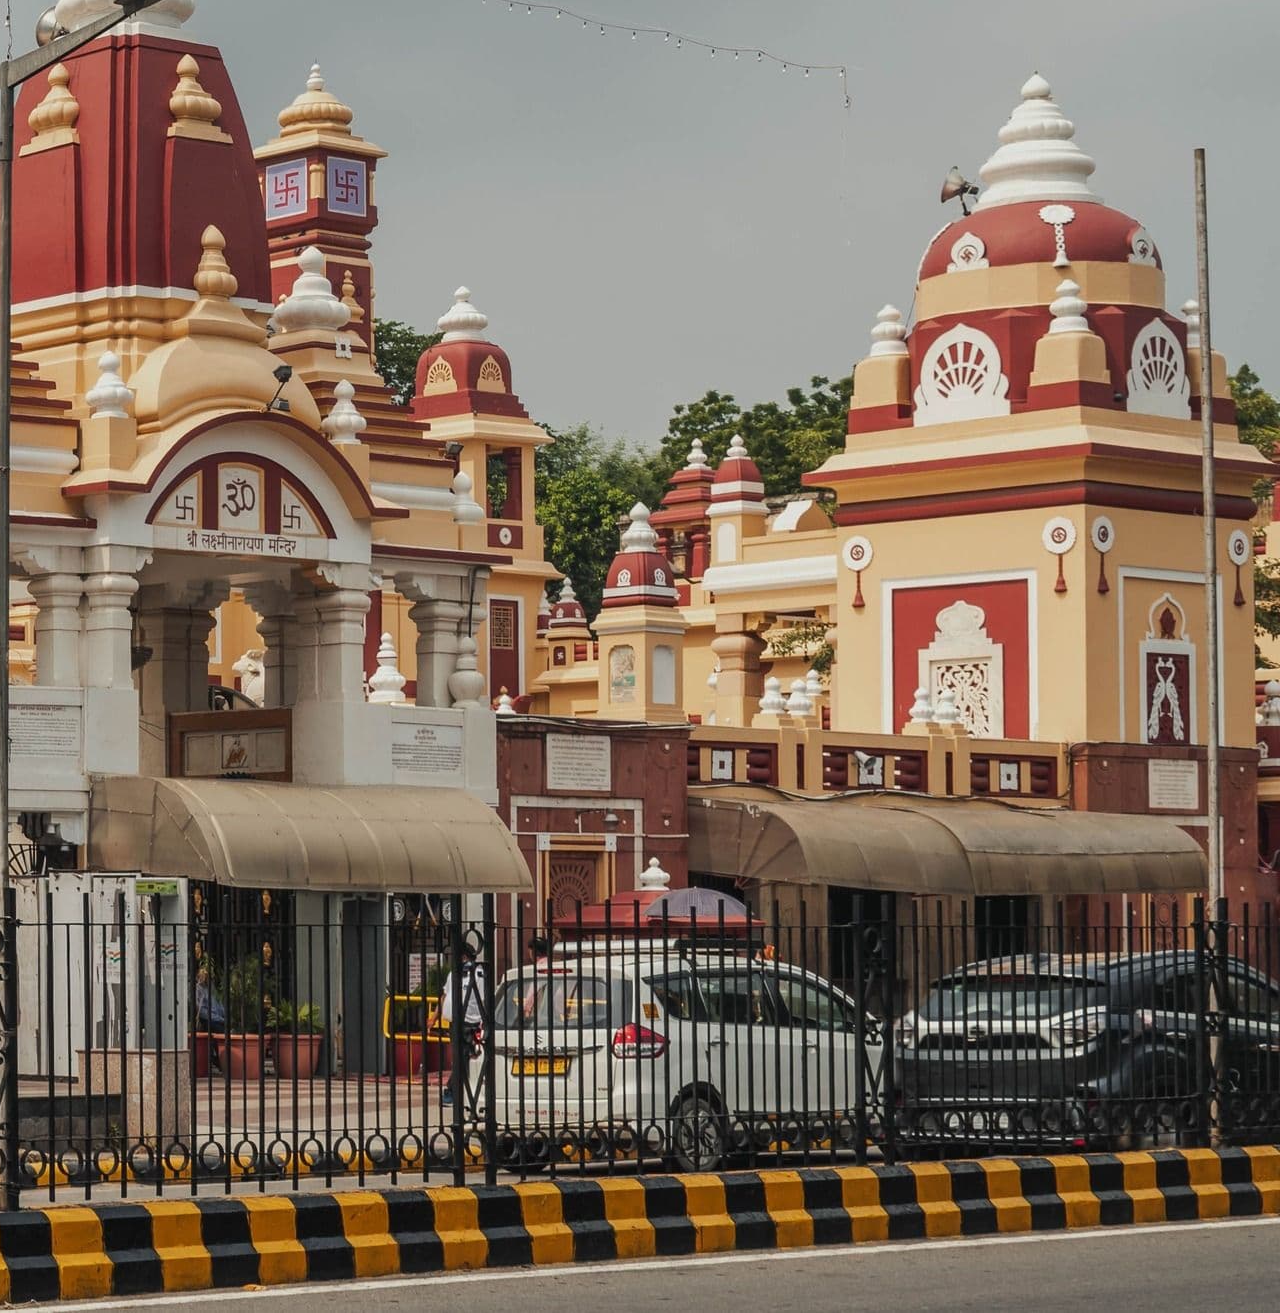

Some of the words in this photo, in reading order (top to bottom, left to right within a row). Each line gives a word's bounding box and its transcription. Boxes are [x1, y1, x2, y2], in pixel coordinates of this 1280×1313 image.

[187, 529, 197, 548] श्री
[201, 532, 264, 552] लक्ष्मीनारायण
[268, 536, 297, 555] मन्दिर
